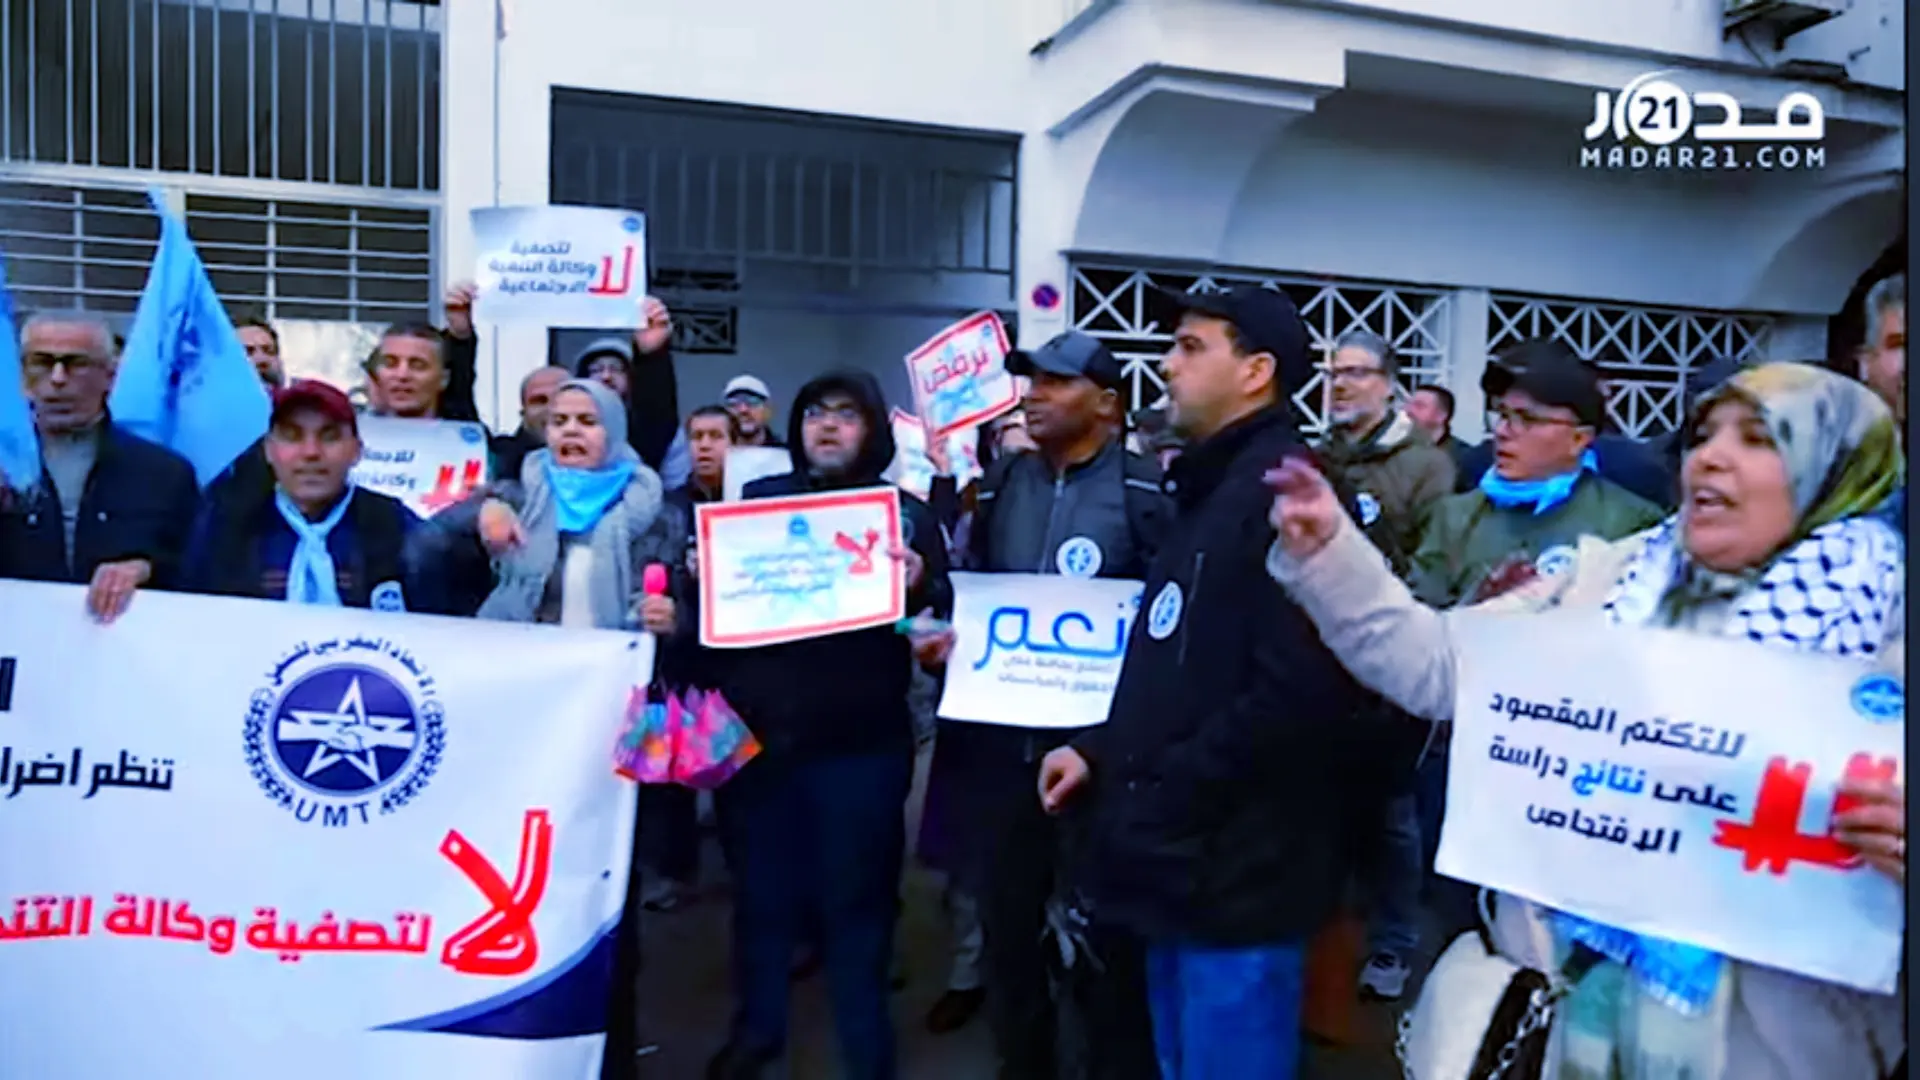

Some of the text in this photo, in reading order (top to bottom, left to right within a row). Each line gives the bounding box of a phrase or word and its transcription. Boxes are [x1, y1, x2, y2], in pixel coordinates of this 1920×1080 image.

[510, 240, 572, 256] لتصفية
[547, 258, 597, 279] وكالة
[973, 601, 1126, 671] نعم
[1488, 692, 1747, 760] للتكتم المقصود
[82, 749, 175, 800] تنظم
[1488, 735, 1569, 778] دراسة
[295, 798, 370, 828] UMT
[1652, 781, 1740, 815] على
[1526, 802, 1682, 855] الافتحاص
[103, 893, 236, 955] وكالة
[245, 906, 434, 964] لتصفية
